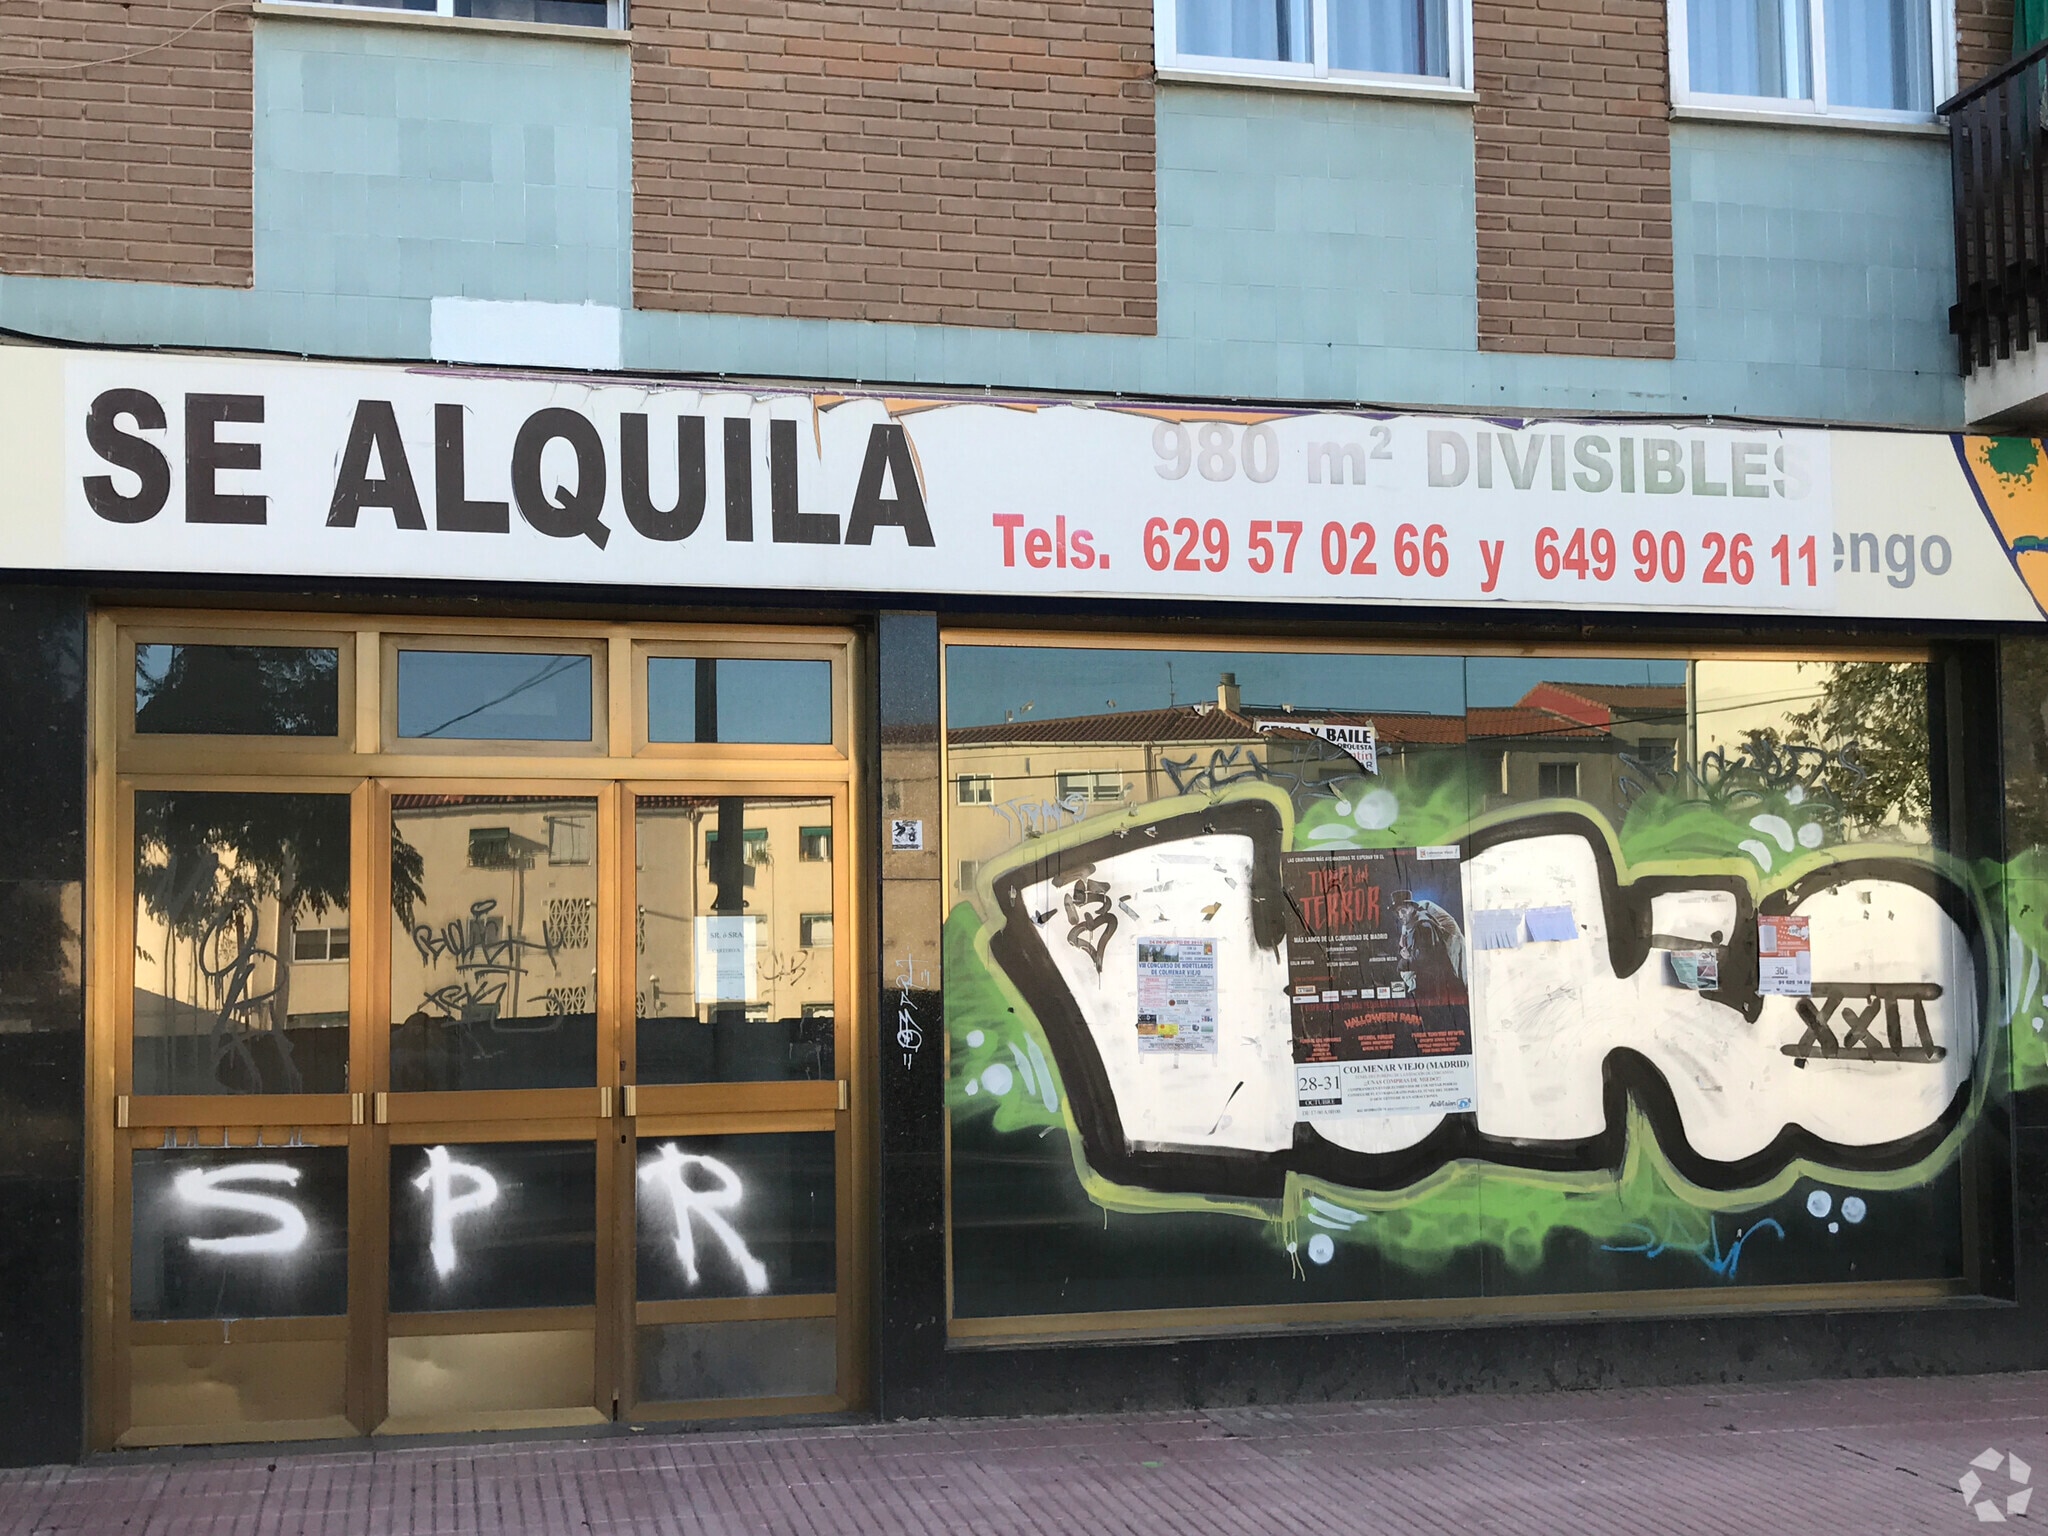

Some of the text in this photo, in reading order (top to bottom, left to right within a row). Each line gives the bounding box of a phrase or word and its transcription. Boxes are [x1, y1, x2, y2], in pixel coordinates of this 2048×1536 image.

[83, 388, 936, 551] SE ALQUILA
[1152, 421, 1280, 484] 980
[1427, 430, 1812, 500] DIVISIBLES
[993, 513, 1817, 592] Tels. 629 57 02 66 y 649 90 26 11
[1326, 728, 1371, 743] BAILE
[1337, 742, 1373, 751] ORQUESTA
[1300, 886, 1380, 935] TERROR
[1344, 1012, 1398, 1030] HALLOWEEN
[1343, 1064, 1396, 1074] COLMENAR
[1398, 1062, 1425, 1071] VIEJO
[1426, 1060, 1469, 1070] (MADRID)
[1299, 1075, 1340, 1091] 28-31
